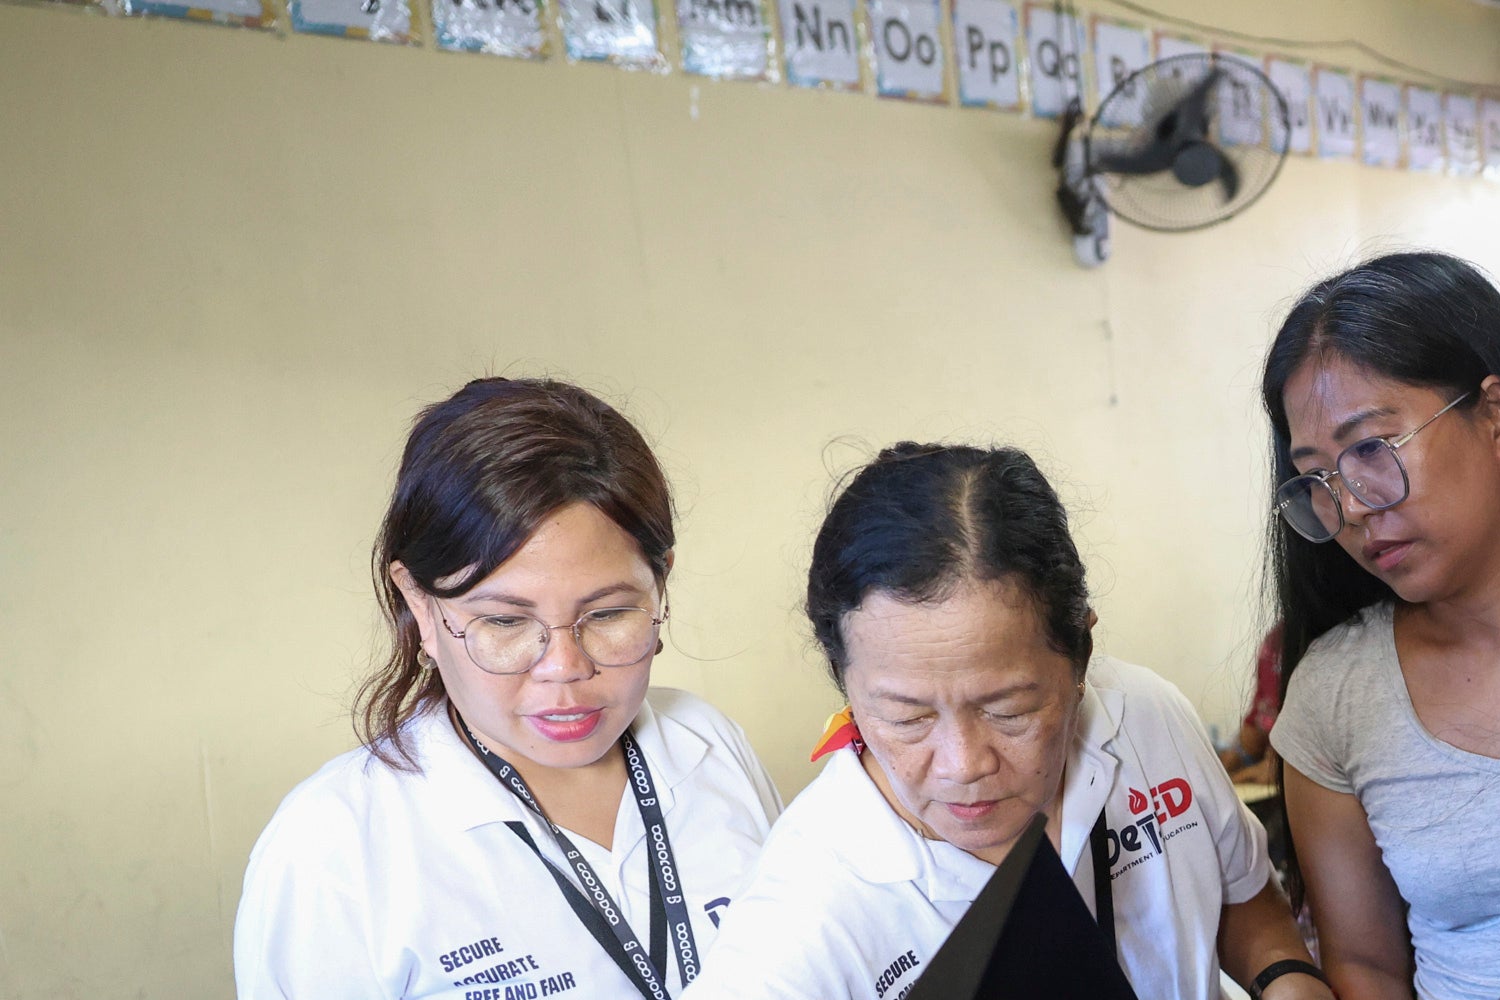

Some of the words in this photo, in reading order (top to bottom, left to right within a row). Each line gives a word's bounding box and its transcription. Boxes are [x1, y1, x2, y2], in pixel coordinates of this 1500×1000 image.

[794, 3, 850, 52] Nn
[883, 18, 936, 66] Oo
[967, 25, 1010, 83] Pp
[1109, 852, 1154, 880] EPARTMENT
[439, 937, 504, 973] SECURE
[676, 922, 701, 985] OOJODOQ
[875, 949, 920, 999] SECURE
[539, 971, 577, 997] FAIR
